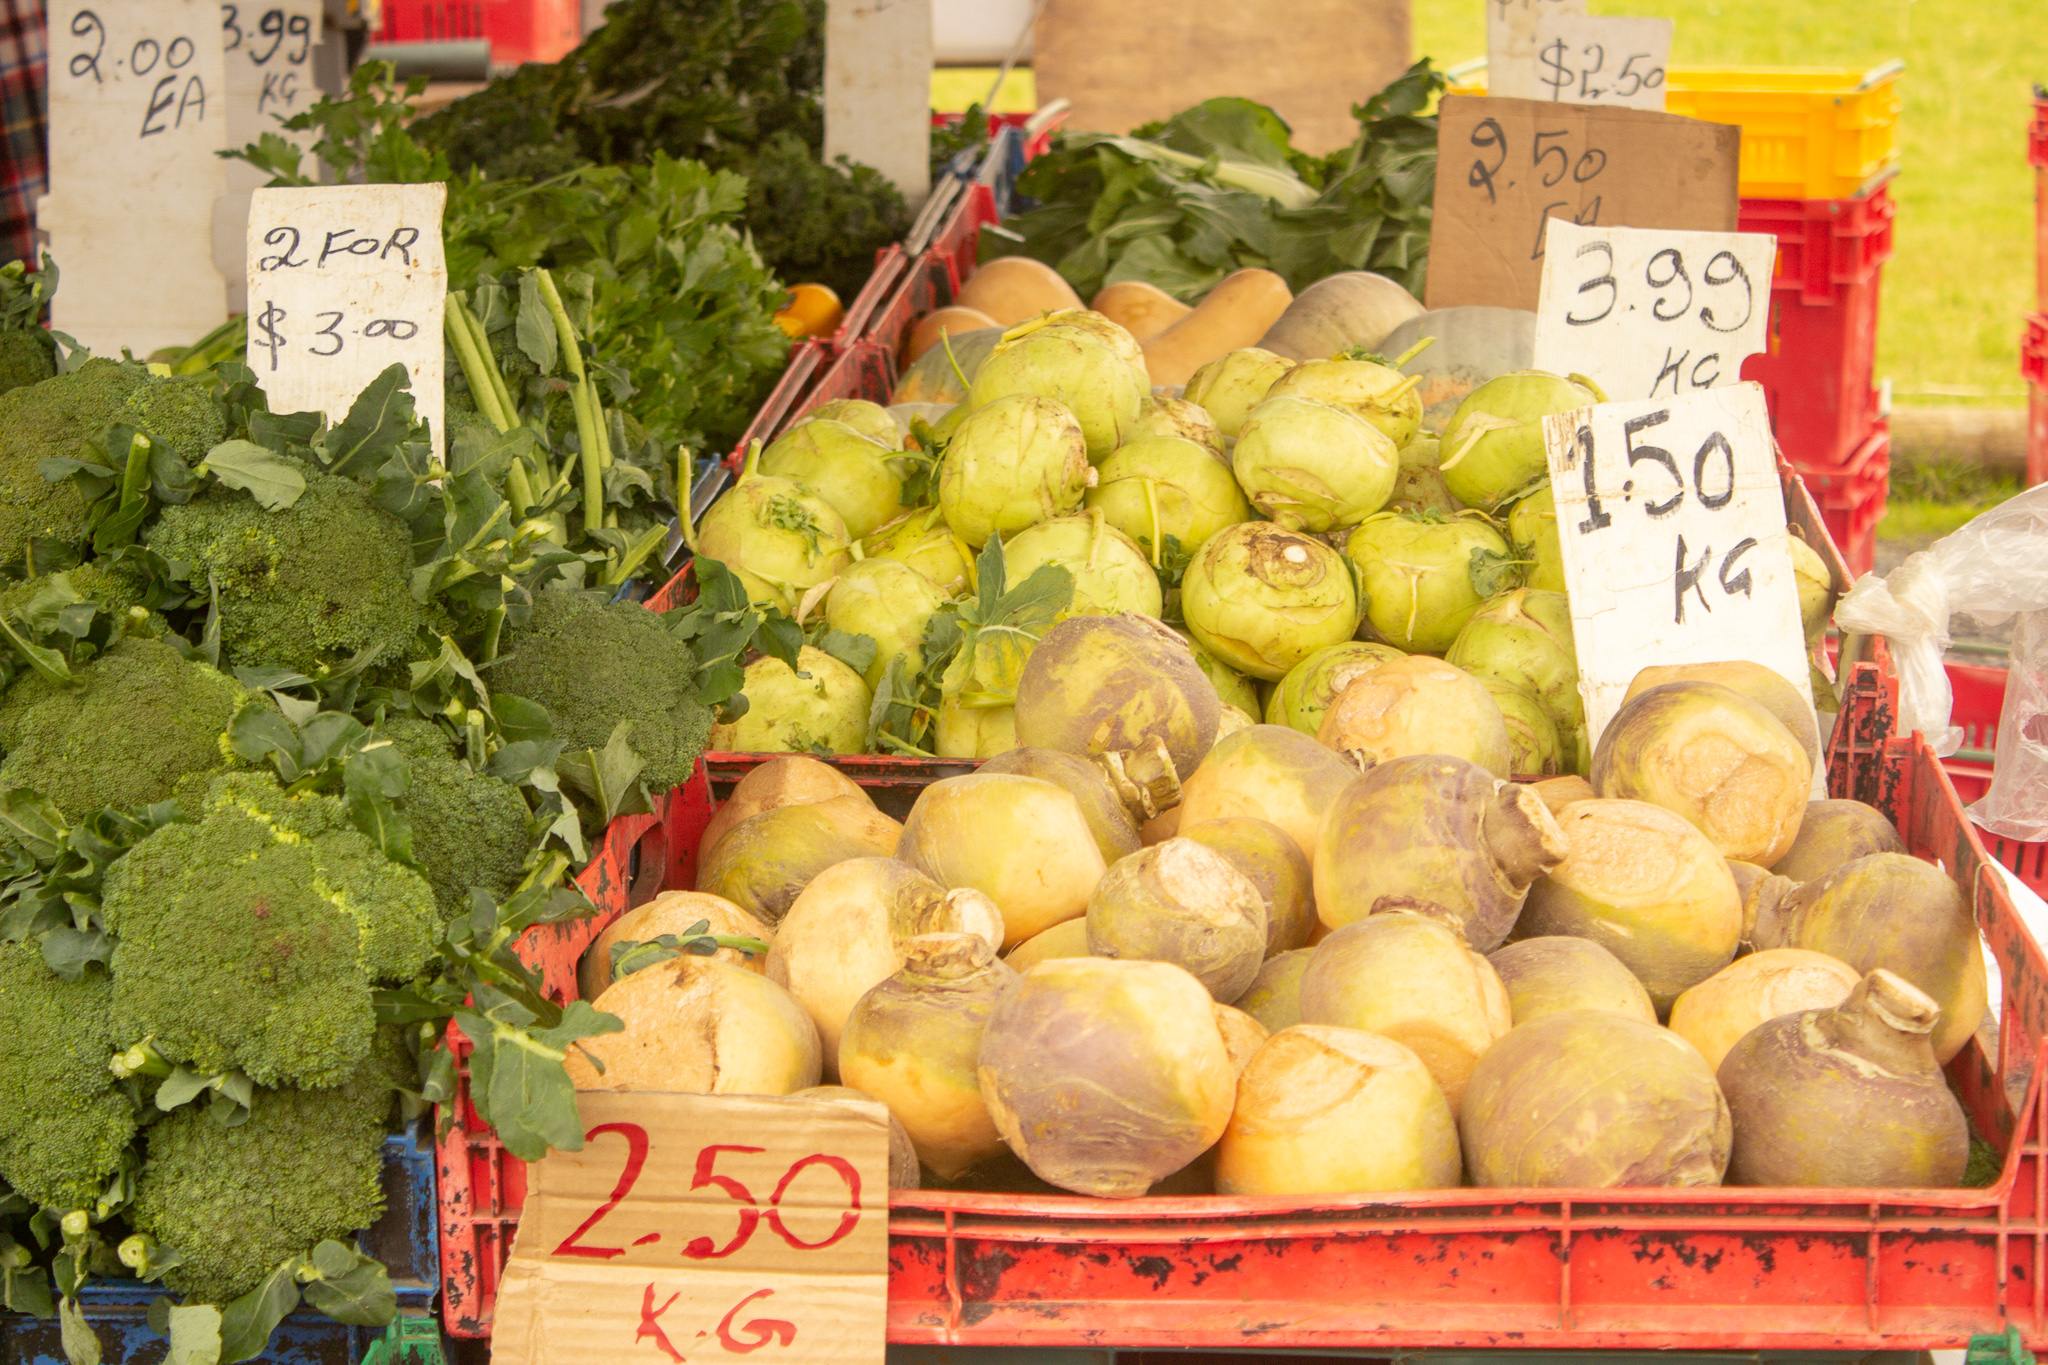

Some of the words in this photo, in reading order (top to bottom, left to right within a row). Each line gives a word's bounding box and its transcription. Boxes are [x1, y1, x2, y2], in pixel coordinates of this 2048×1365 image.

[69, 10, 195, 83] 2.00
[222, 5, 312, 66] 3.99
[1540, 37, 1665, 101] $2.50
[140, 75, 206, 138] EA
[258, 70, 300, 114] KG
[1468, 117, 1606, 204] 2.50
[260, 226, 309, 272] 2
[1566, 241, 1753, 333] 3.99
[254, 300, 287, 371] $
[308, 311, 418, 356] 3.00
[1649, 346, 1721, 399] KG
[1567, 408, 1735, 535] 1.50
[1674, 533, 1759, 625] KG
[551, 1121, 862, 1260] 2.50
